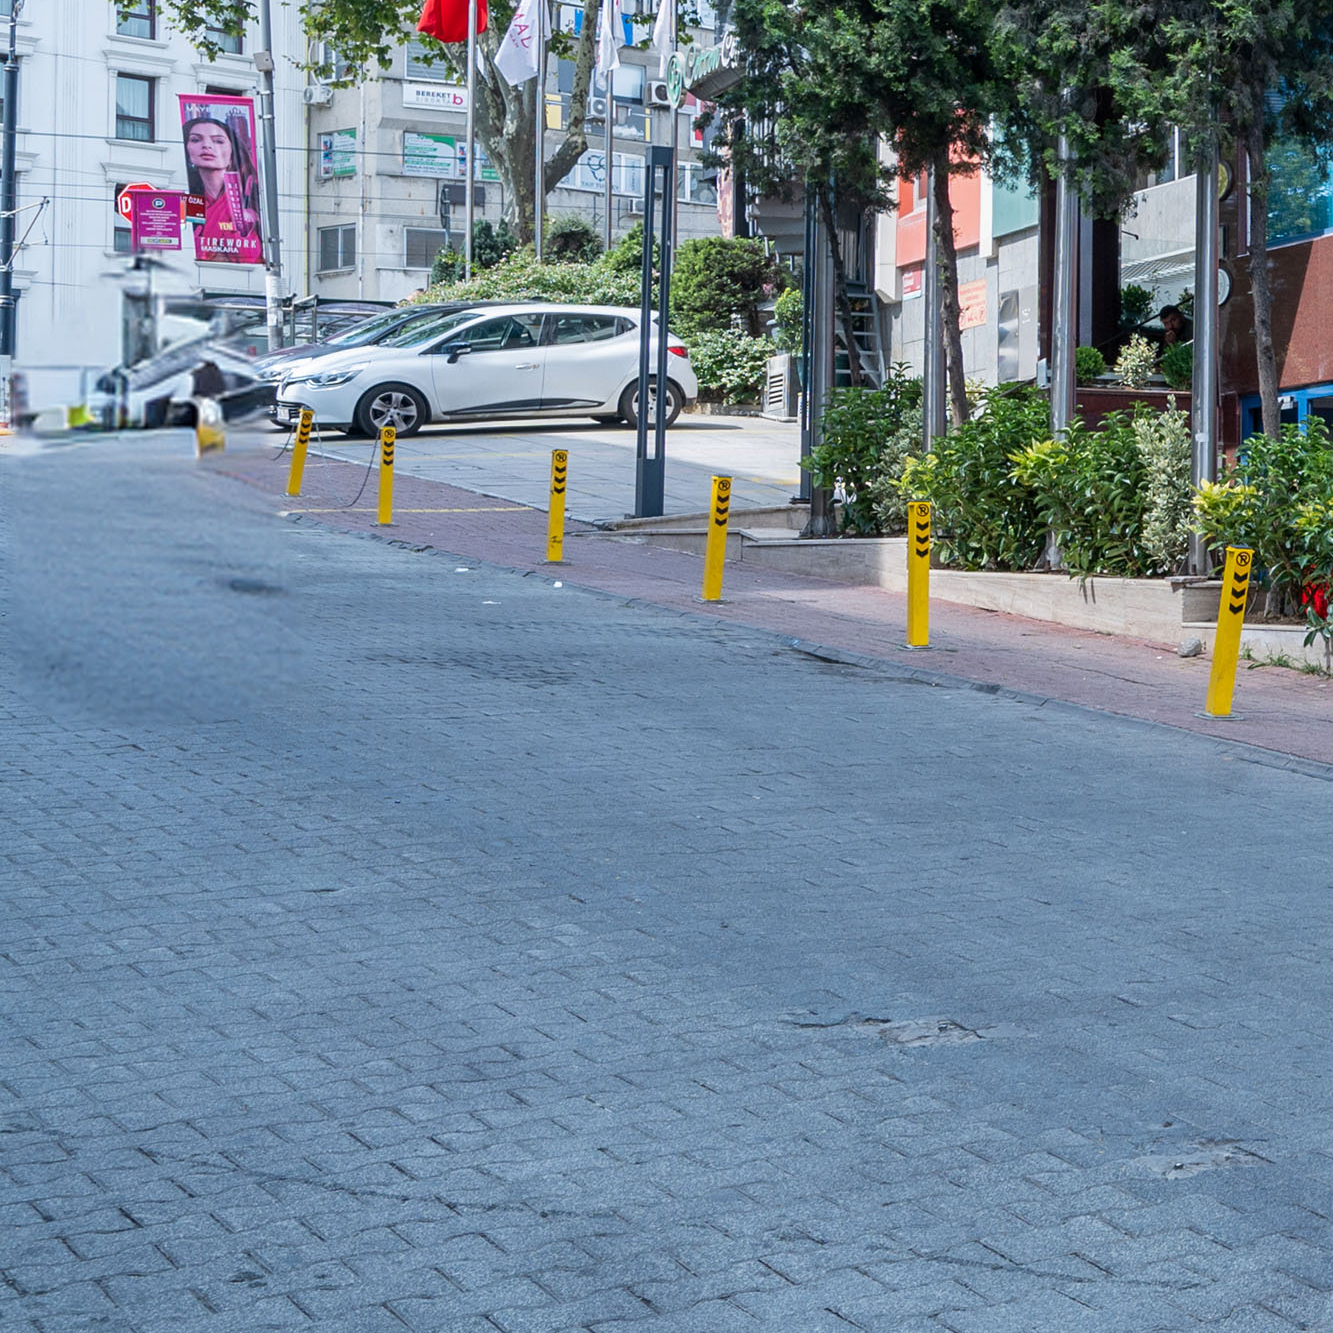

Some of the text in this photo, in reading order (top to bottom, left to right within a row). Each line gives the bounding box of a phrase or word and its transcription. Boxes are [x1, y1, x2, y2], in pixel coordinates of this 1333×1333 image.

[416, 90, 451, 98] BEREKET
[200, 237, 257, 249] FIREWORK
[201, 245, 239, 254] MASKARA
